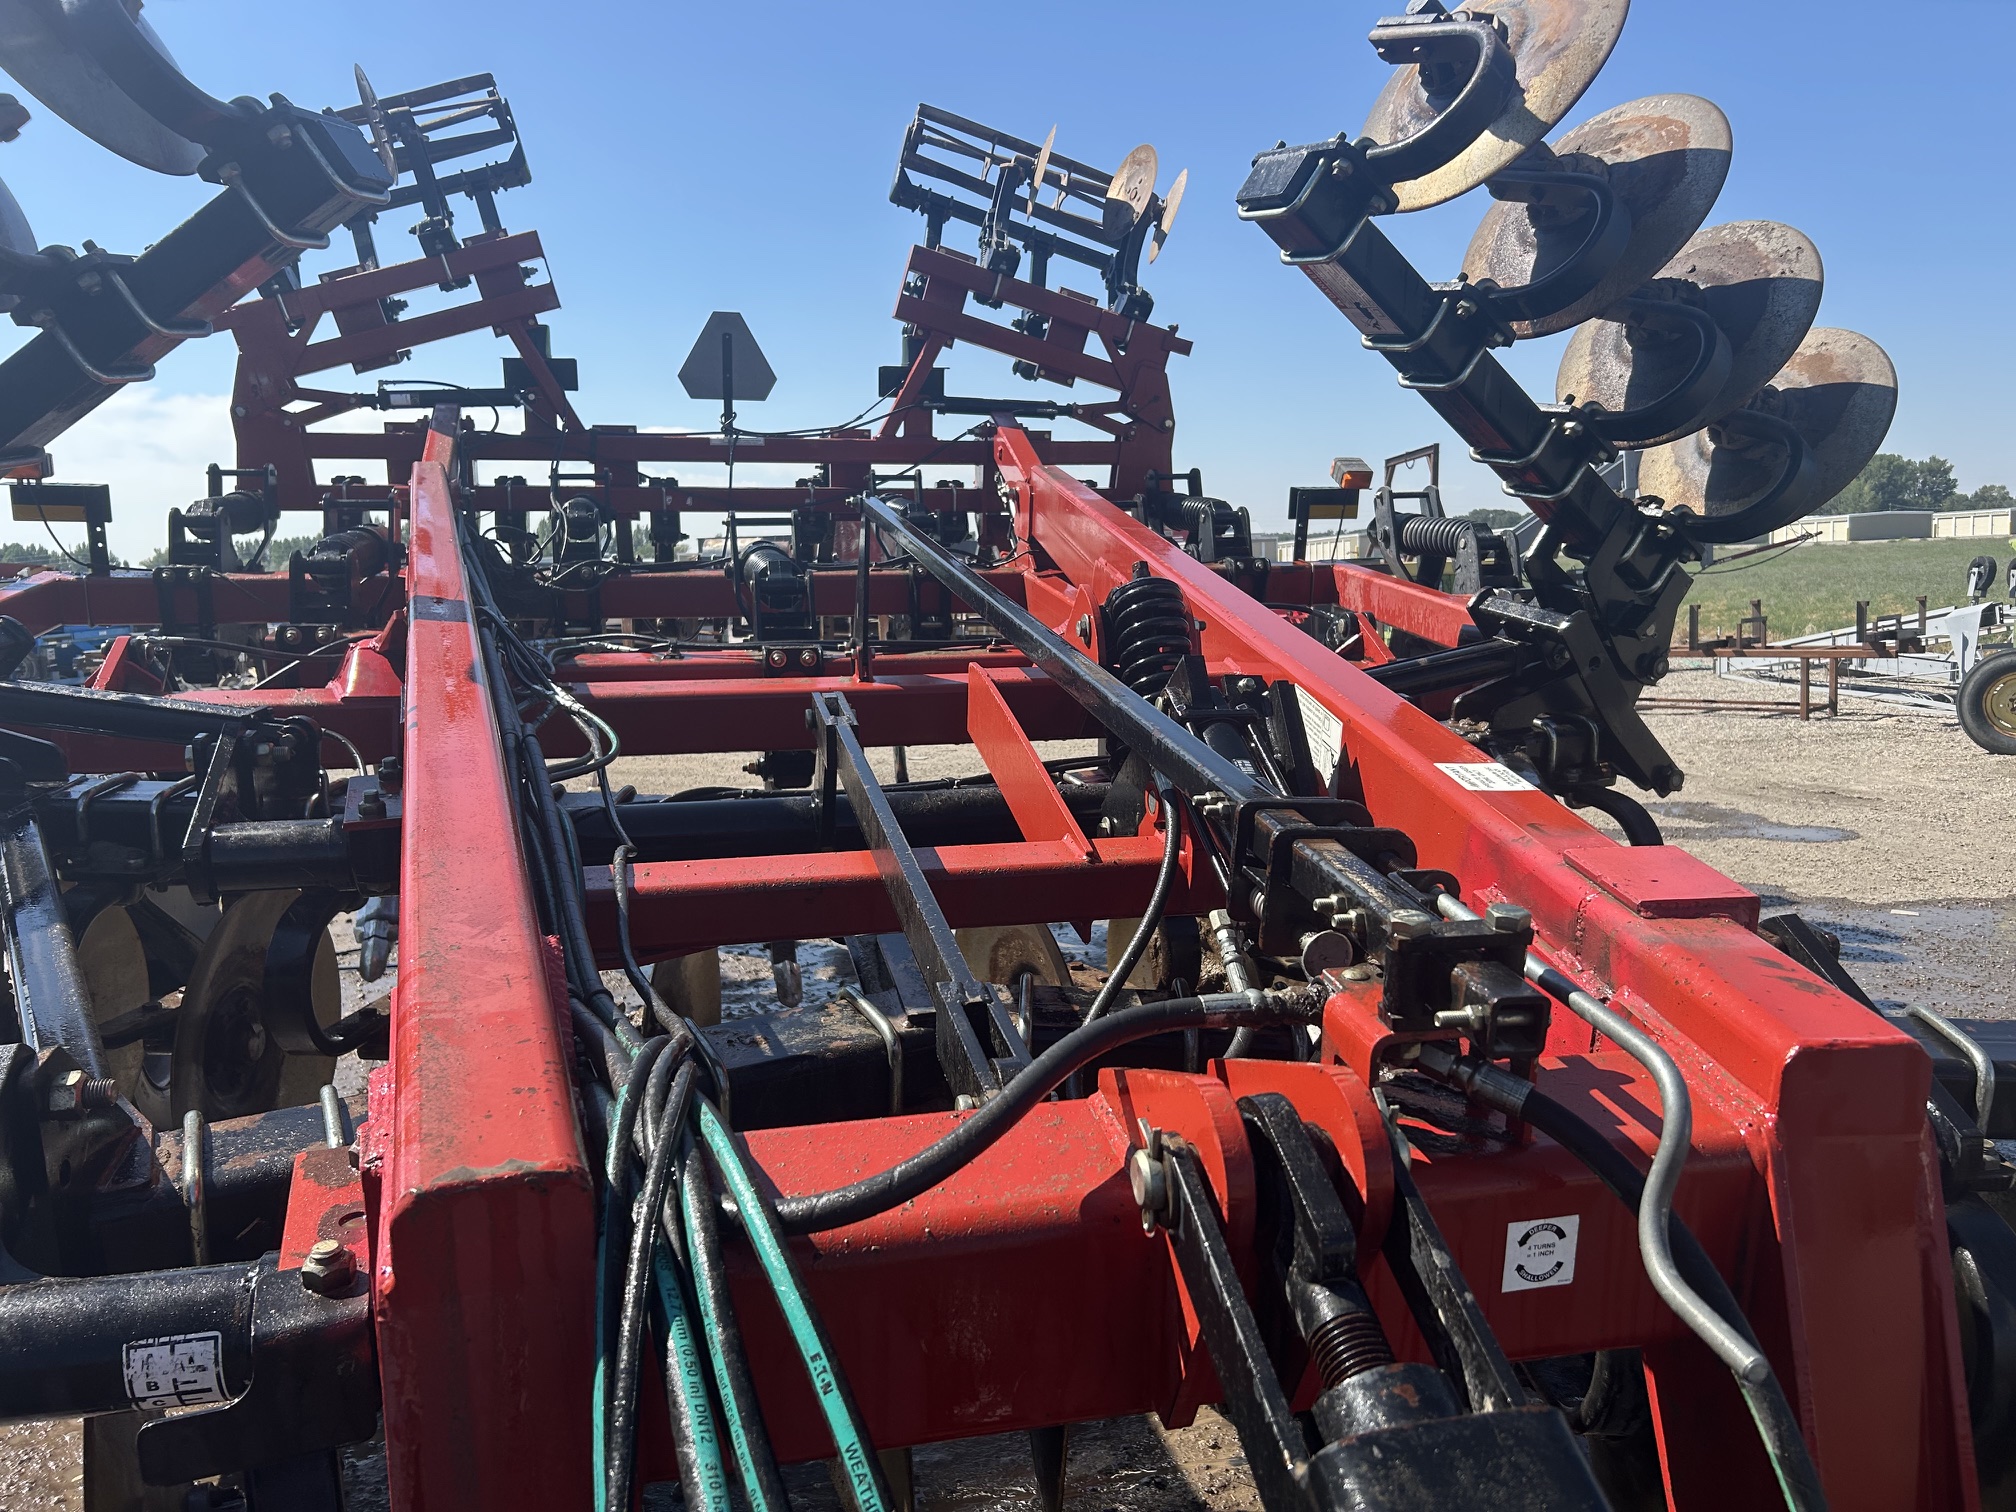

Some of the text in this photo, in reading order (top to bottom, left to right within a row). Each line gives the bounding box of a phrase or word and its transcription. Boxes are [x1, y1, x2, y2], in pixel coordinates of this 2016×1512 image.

[1528, 1224, 1557, 1236] DEEPER
[1533, 1242, 1556, 1250] TURNS
[1519, 1265, 1559, 1281] SHALLOWER
[145, 1381, 160, 1392] B
[666, 1287, 682, 1309] 12.7
[680, 1344, 699, 1377] (0.50
[694, 1404, 713, 1444] DN12
[705, 1461, 722, 1490] 310
